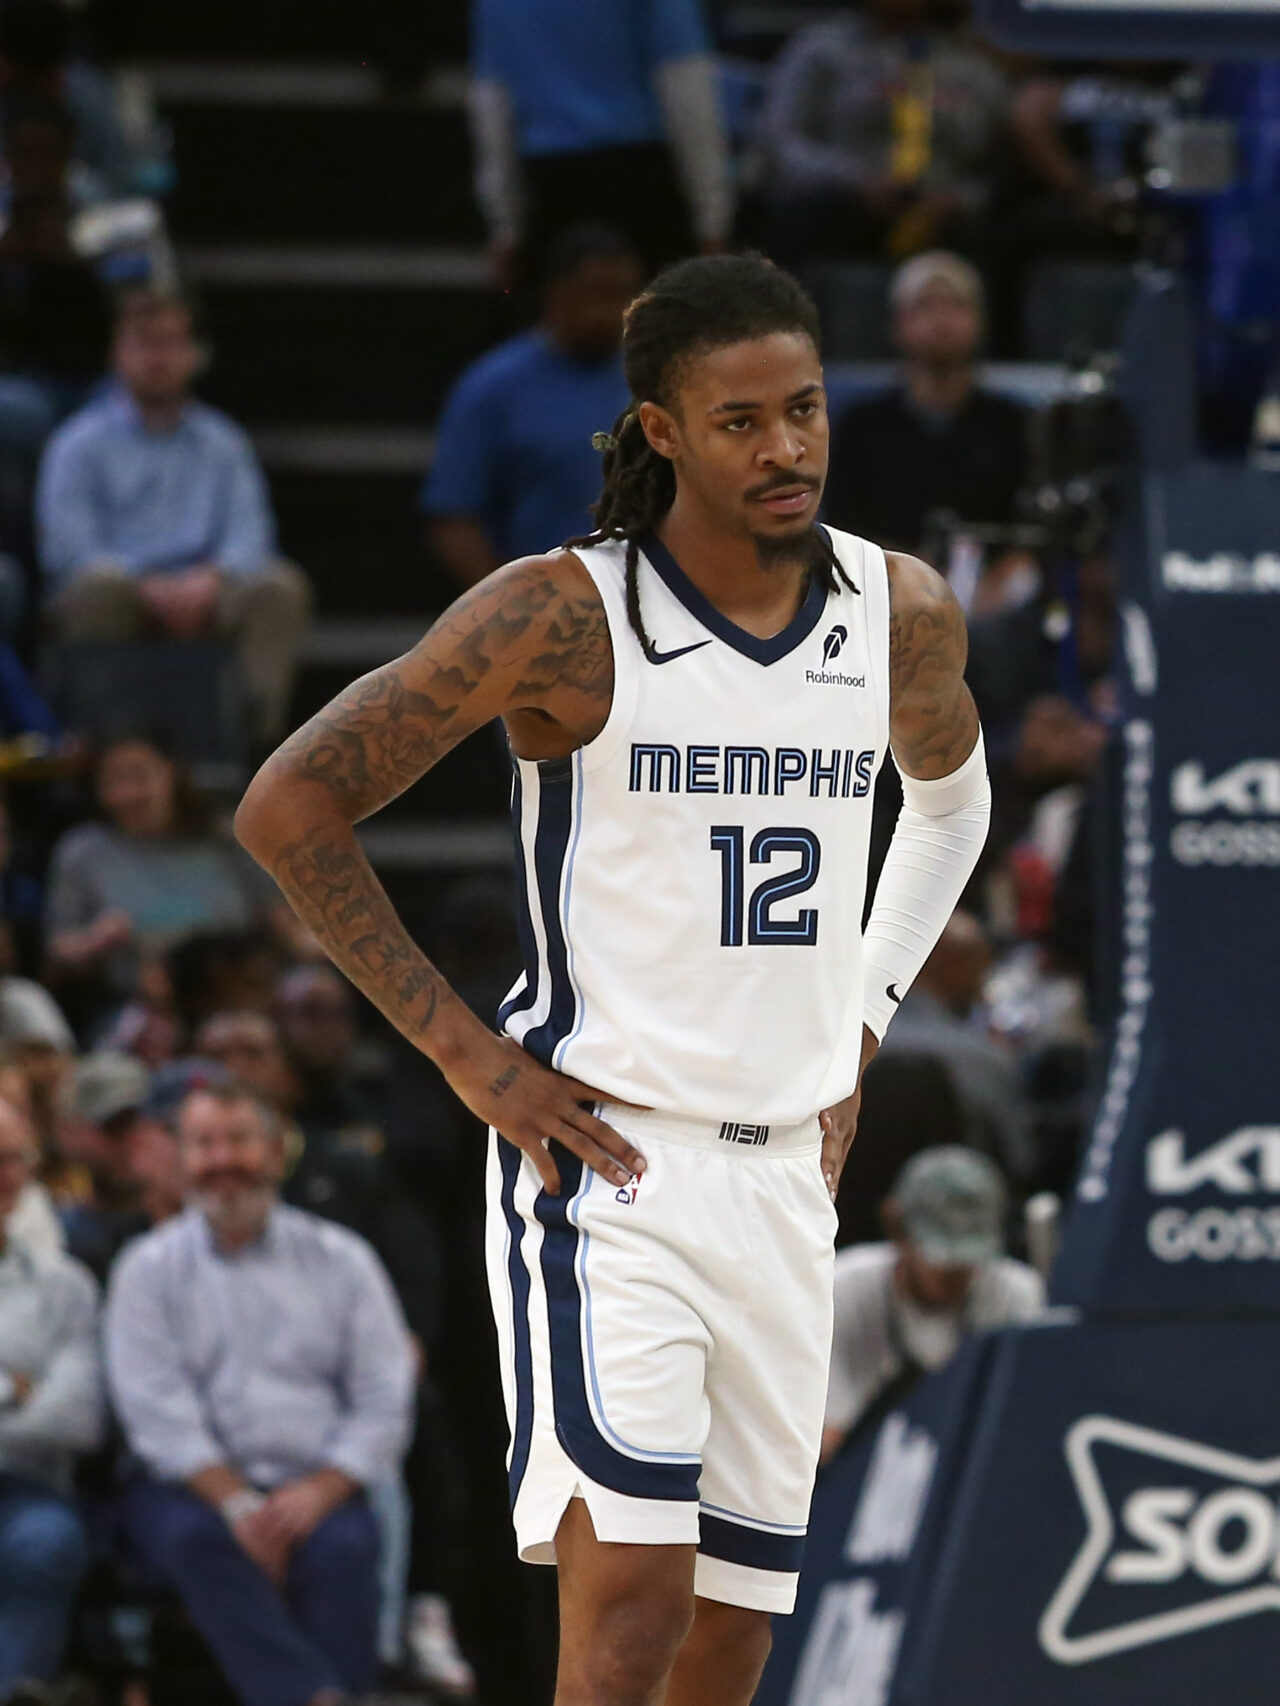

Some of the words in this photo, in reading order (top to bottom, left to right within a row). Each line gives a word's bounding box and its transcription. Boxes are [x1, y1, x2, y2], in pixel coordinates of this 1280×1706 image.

[805, 670, 866, 688] Robinhood
[628, 743, 875, 798] MEMPHIS
[710, 825, 821, 946] 12
